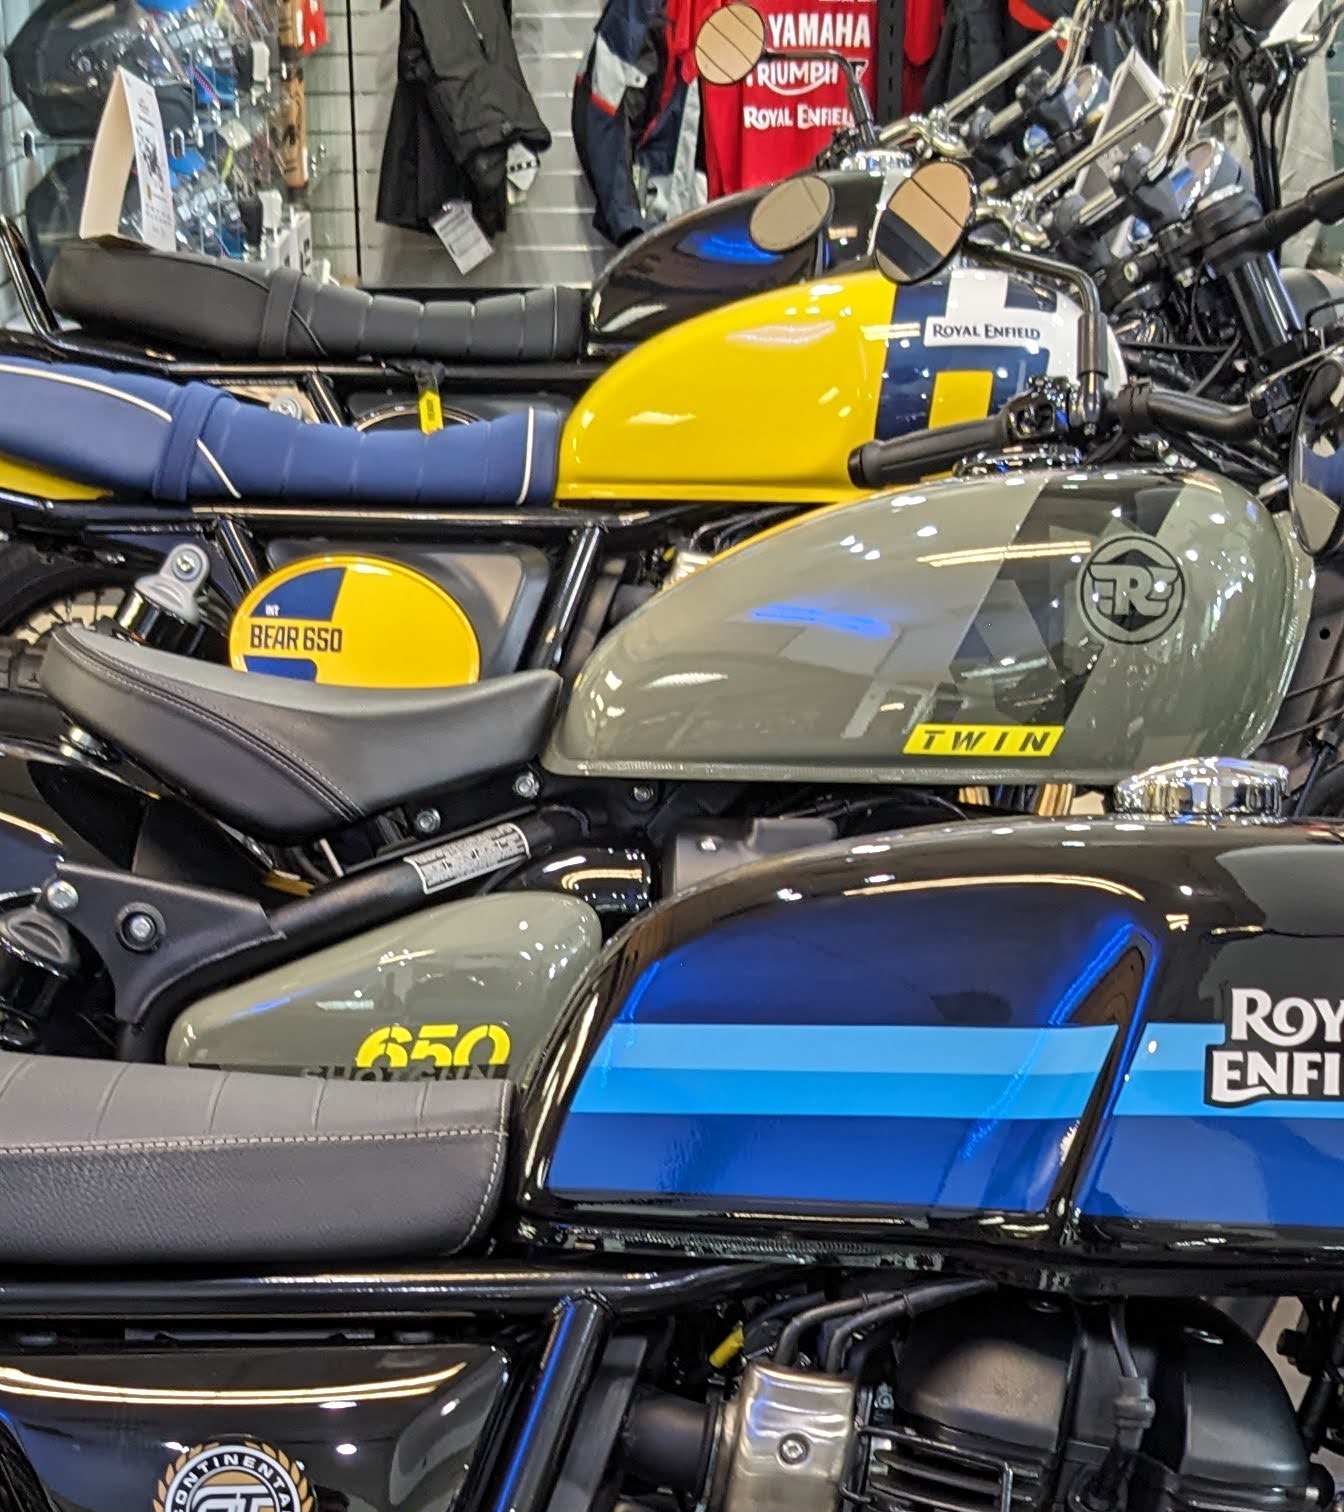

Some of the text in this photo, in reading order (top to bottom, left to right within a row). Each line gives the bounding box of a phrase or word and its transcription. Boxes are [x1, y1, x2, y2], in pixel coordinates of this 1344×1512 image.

[768, 13, 871, 48] YAMAHA
[743, 104, 856, 130] ROYAL ENFIEL
[932, 323, 1041, 340] ROYAL ENFIELD
[250, 624, 343, 652] BEAR 650
[923, 730, 1051, 752] TWIN
[356, 1025, 511, 1068] 650
